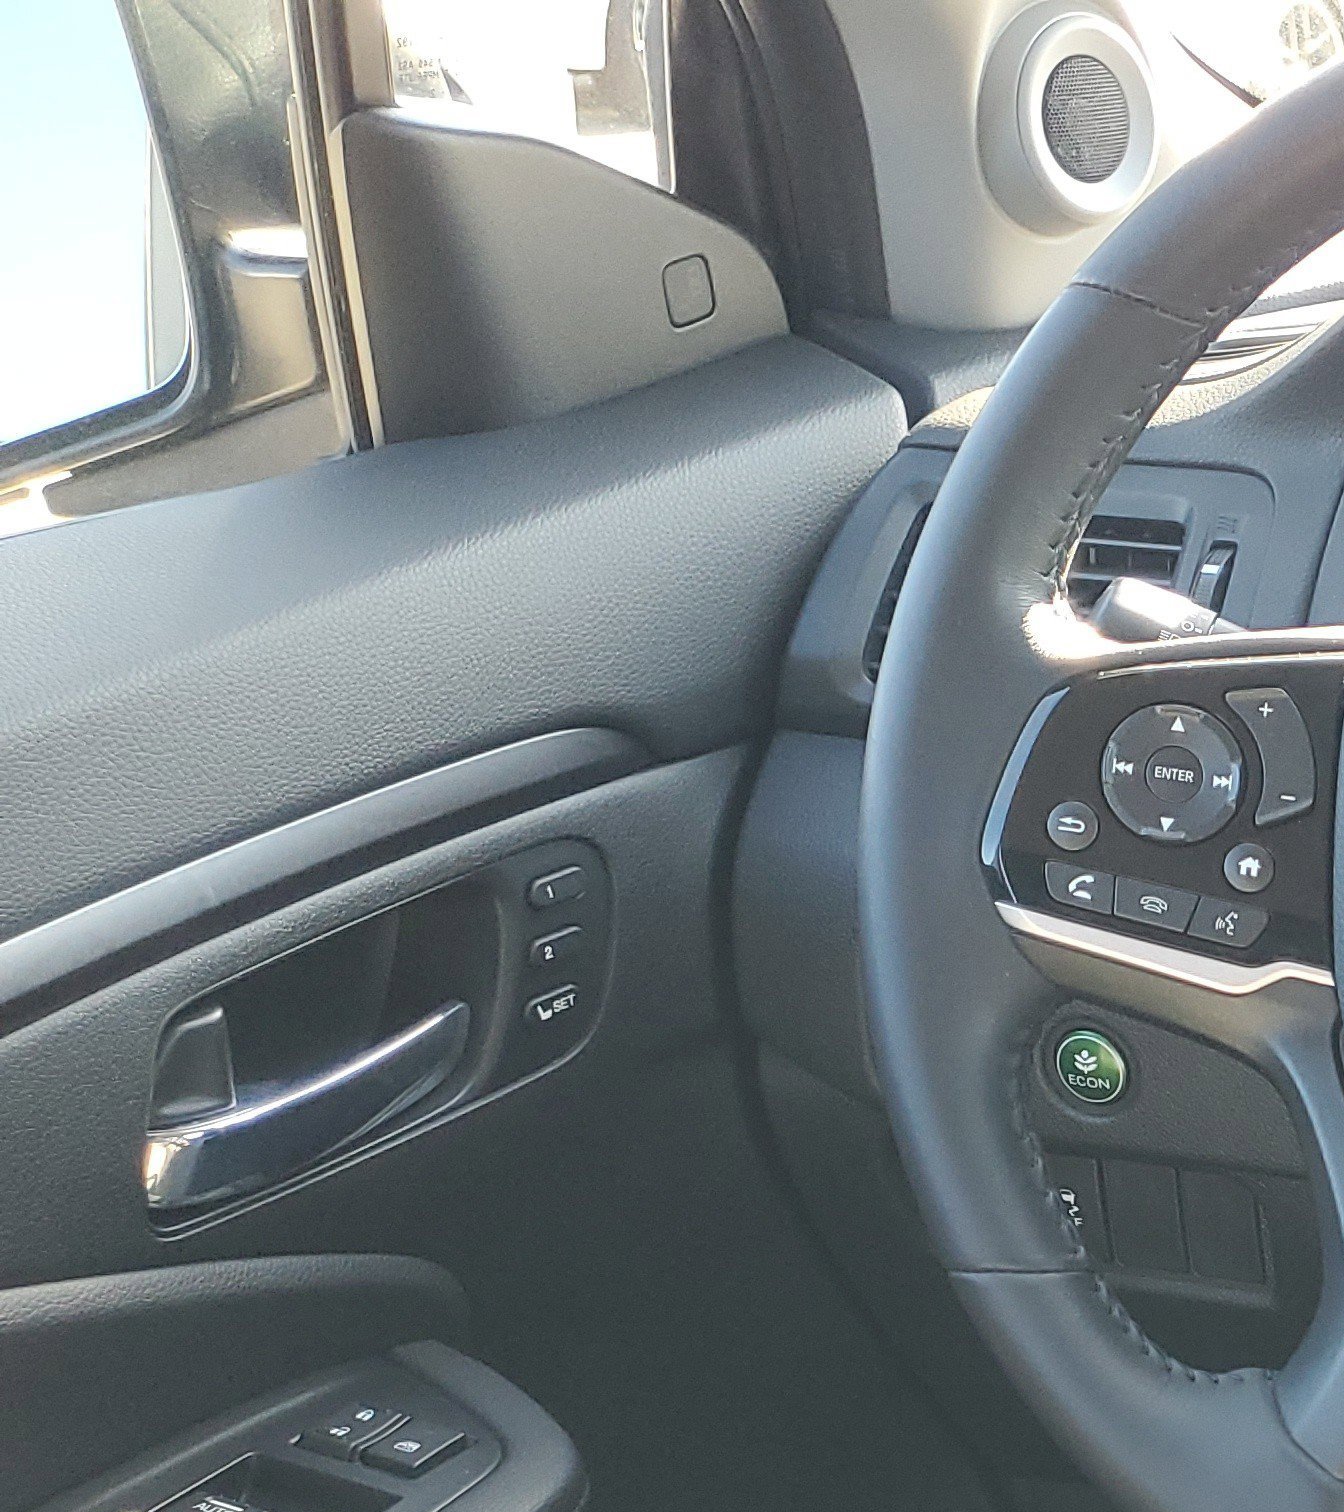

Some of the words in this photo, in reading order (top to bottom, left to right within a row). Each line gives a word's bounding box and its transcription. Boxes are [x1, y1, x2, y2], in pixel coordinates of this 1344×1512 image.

[1154, 766, 1194, 785] ENTER
[546, 885, 555, 899] 1
[544, 946, 555, 960] 2
[553, 994, 576, 1013] SET
[1068, 1074, 1111, 1091] ECON
